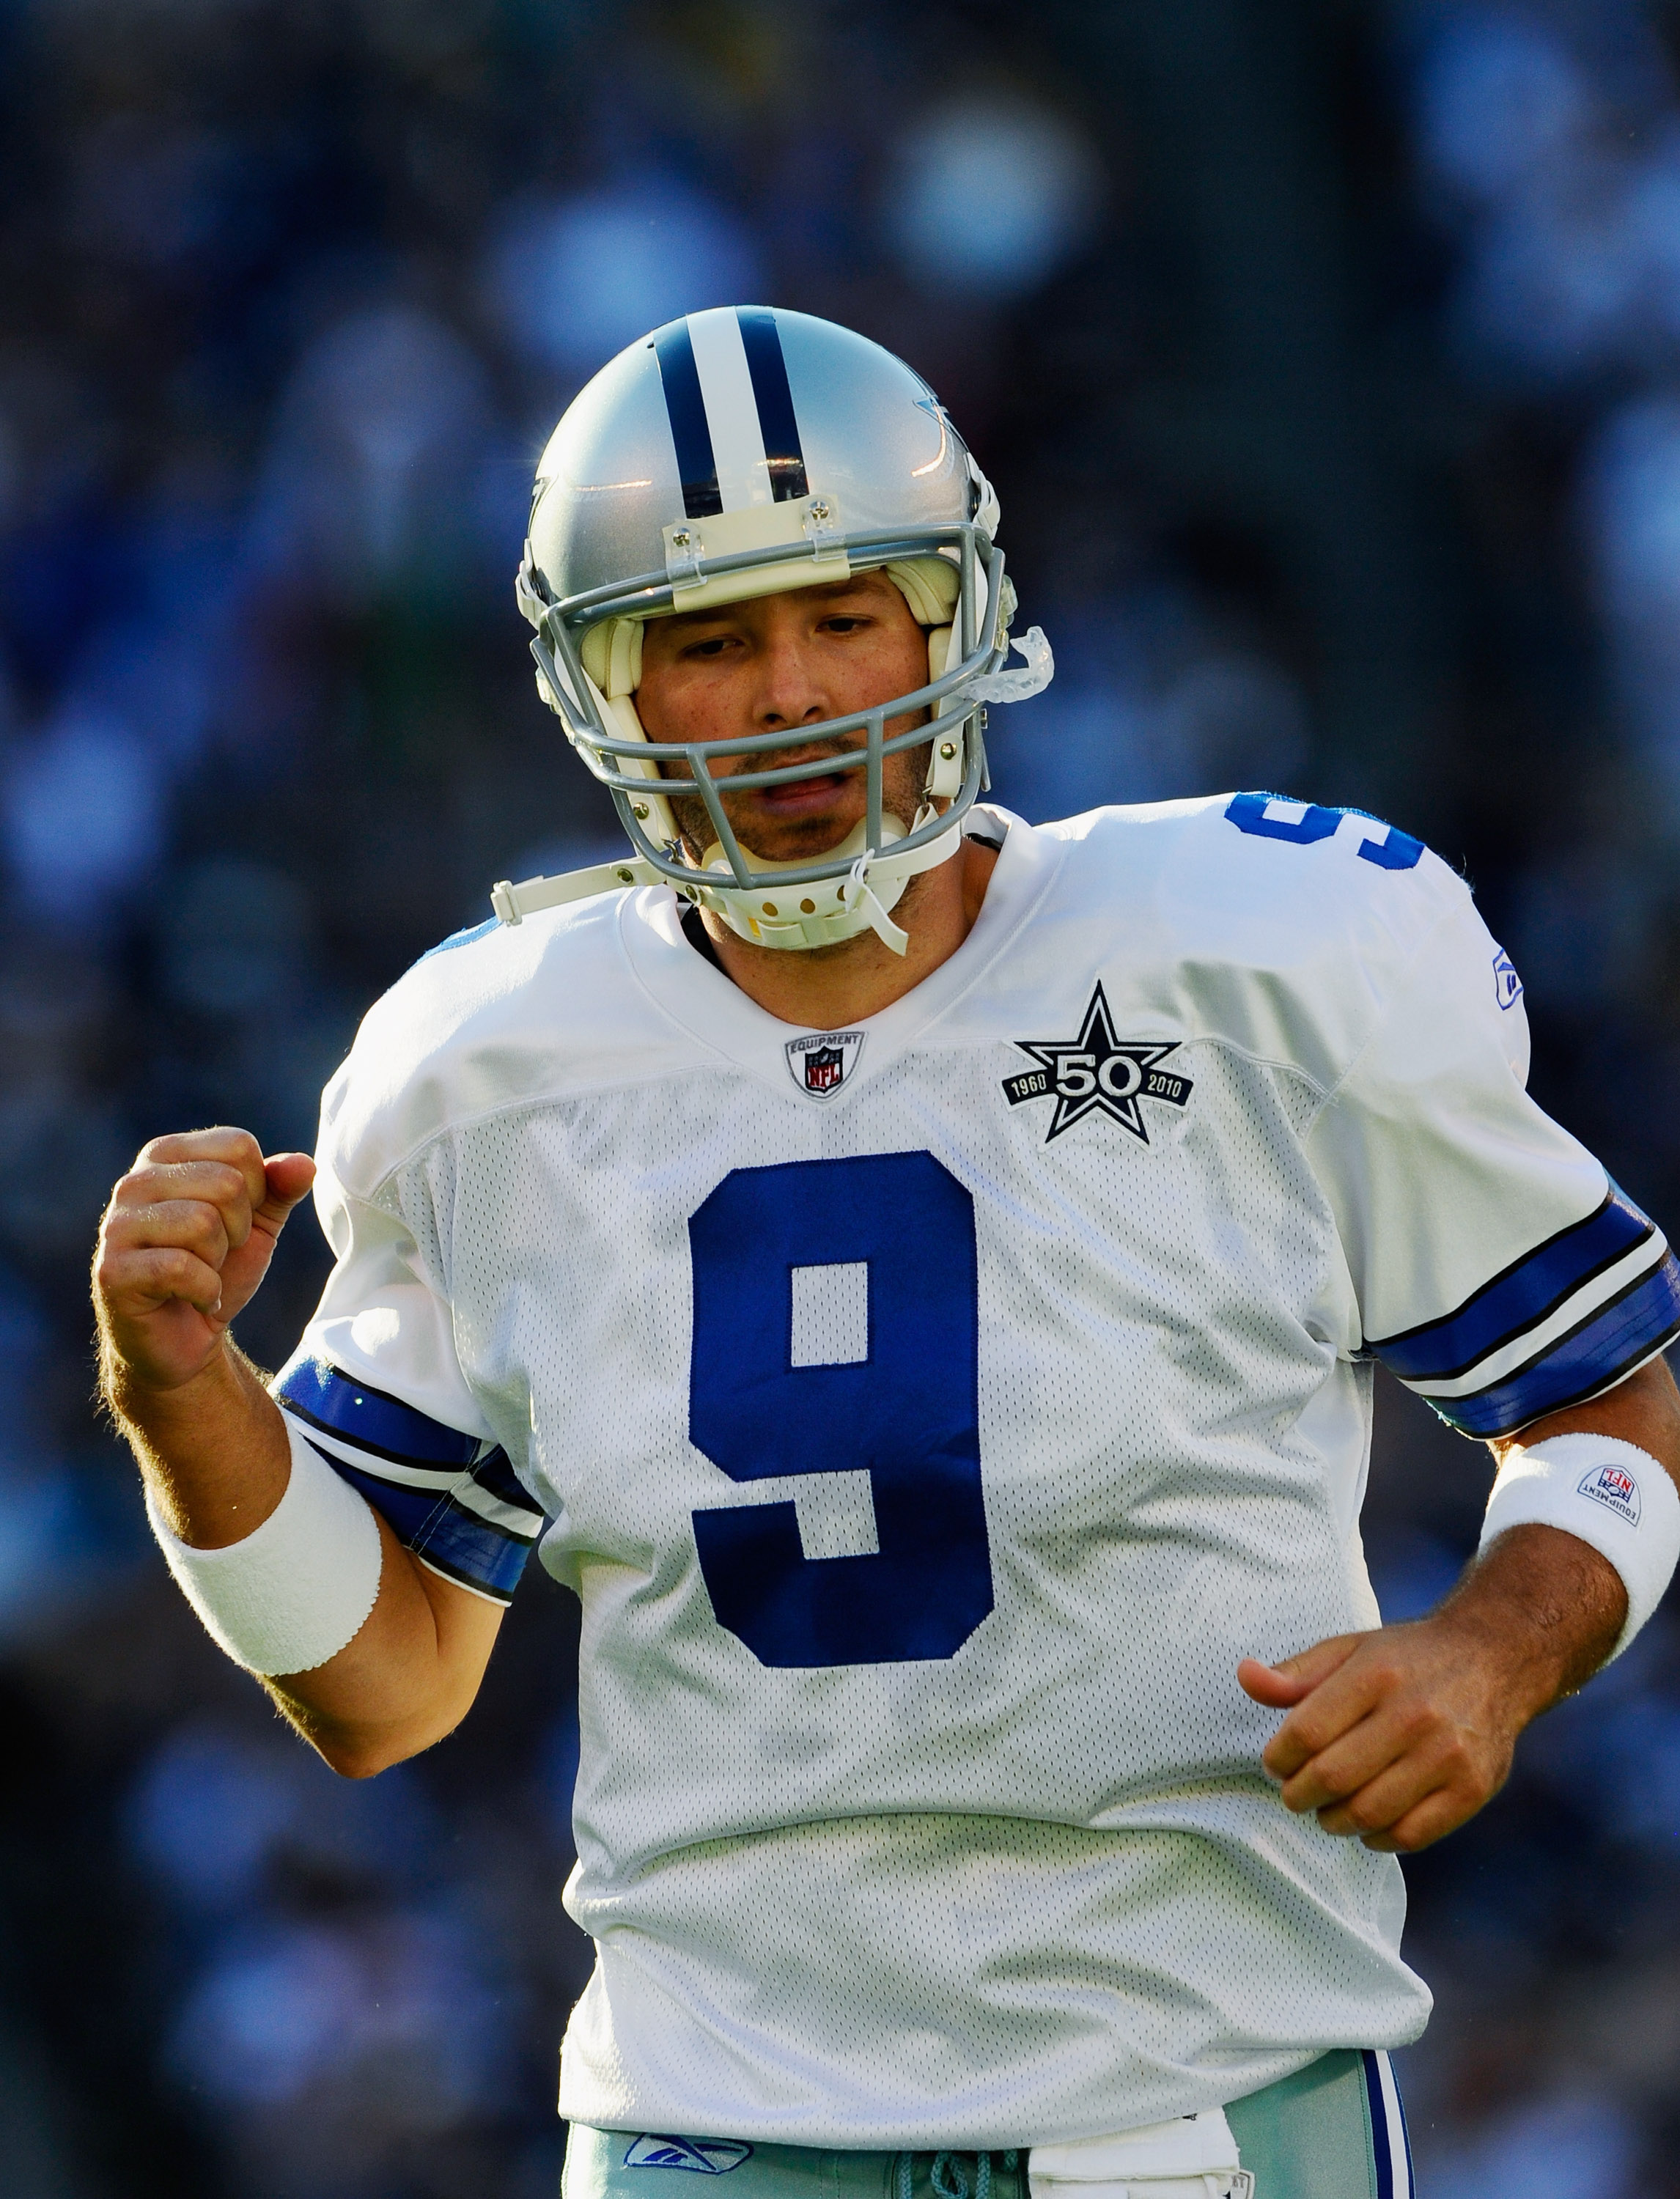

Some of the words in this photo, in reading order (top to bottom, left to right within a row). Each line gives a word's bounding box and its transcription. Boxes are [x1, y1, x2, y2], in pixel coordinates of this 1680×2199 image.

[790, 1034, 858, 1054] EQUIPMENT
[808, 1064, 839, 1087] NFL
[1011, 1074, 1047, 1097] 1960
[1055, 1054, 1141, 1097] 50
[1148, 1074, 1182, 1098] 2010
[688, 1149, 995, 1668] 9
[1606, 1470, 1632, 1492] NFL
[1583, 1484, 1636, 1520] EQUIPMENT
